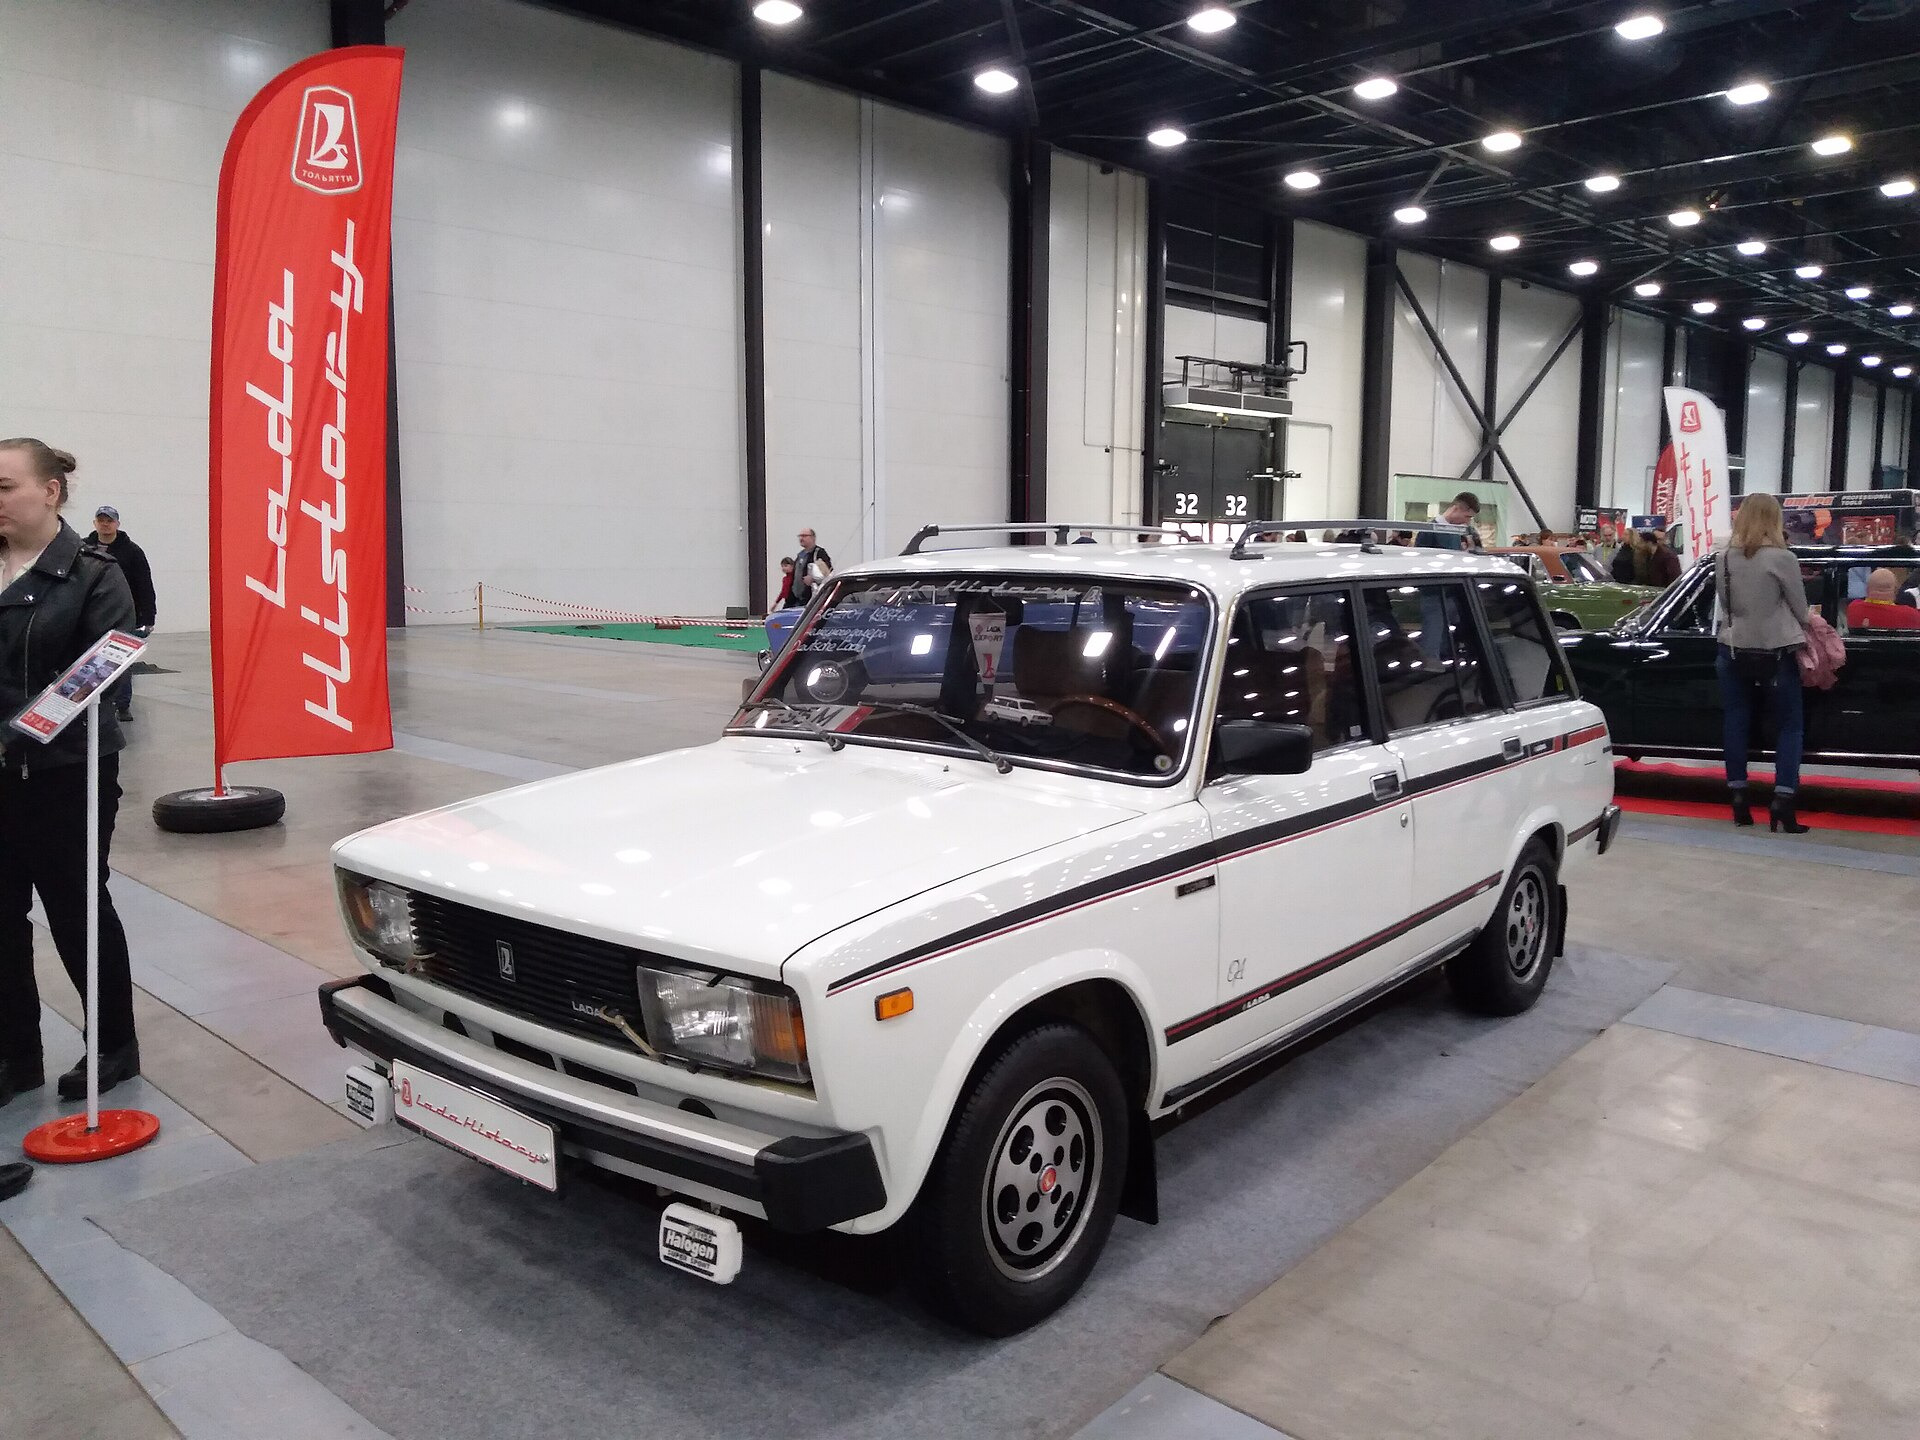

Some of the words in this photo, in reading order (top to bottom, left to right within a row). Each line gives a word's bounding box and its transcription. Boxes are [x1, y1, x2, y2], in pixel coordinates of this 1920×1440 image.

[302, 169, 353, 182] ТОЛЬЯТТИ
[245, 268, 294, 609] Lada
[300, 218, 364, 732] History
[1174, 493, 1199, 515] 32
[1225, 495, 1247, 516] 32
[572, 1001, 600, 1017] LADA
[665, 1229, 715, 1260] Halogen
